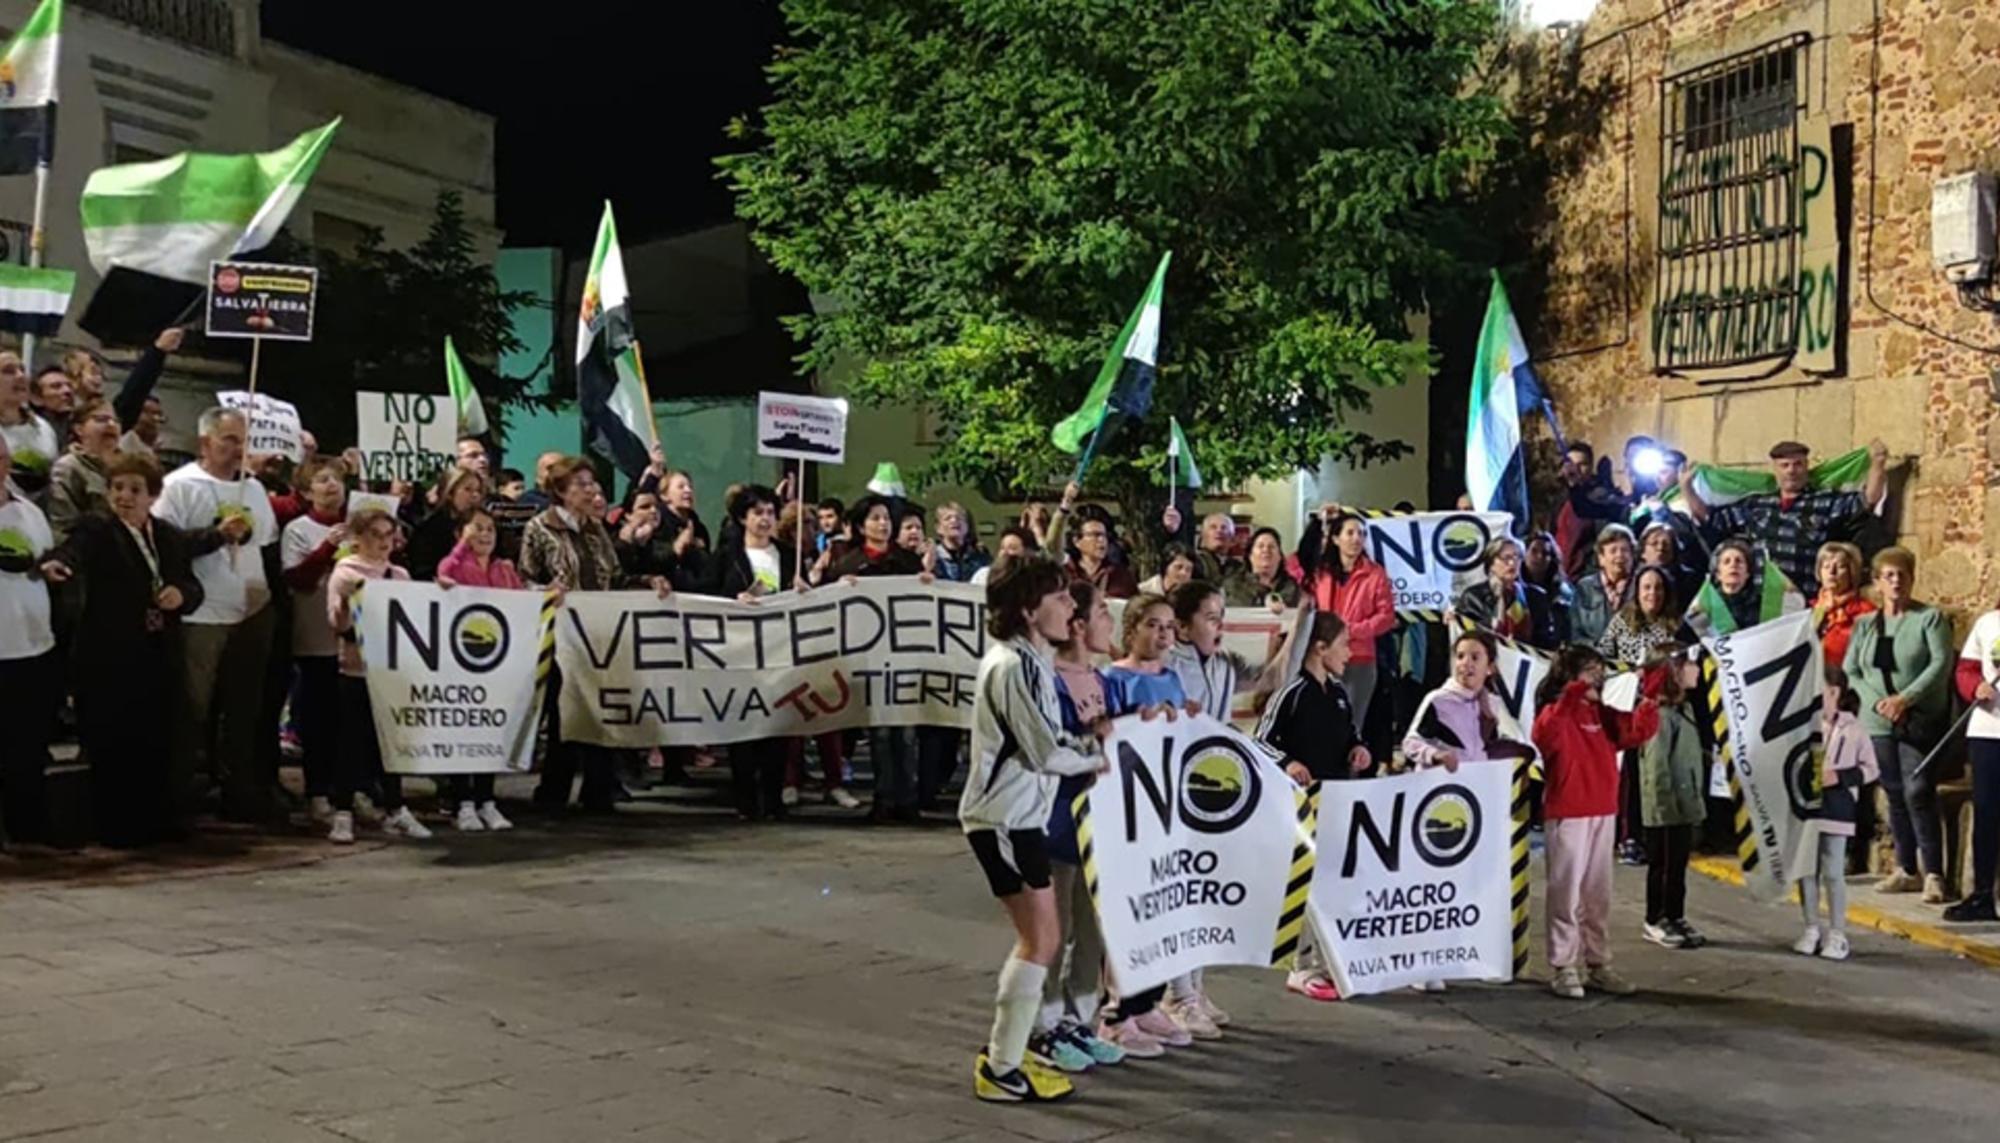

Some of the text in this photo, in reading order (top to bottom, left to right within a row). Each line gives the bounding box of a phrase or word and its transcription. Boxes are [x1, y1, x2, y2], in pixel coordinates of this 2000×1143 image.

[1661, 144, 1827, 258] STOP
[384, 392, 436, 425] NO
[392, 423, 430, 455] AL
[1369, 514, 1491, 574] NO
[388, 598, 510, 673] NO
[410, 684, 487, 704] MACRO
[600, 686, 770, 725] SALVA
[774, 669, 850, 722] TU
[391, 706, 507, 727] VERTEDERO
[433, 744, 453, 758] TU
[1117, 736, 1263, 842] NO
[1341, 783, 1482, 878] NO
[1150, 849, 1218, 885] MACRO
[1128, 879, 1247, 923] VERTEDERO
[1366, 881, 1456, 913] MACRO
[1336, 904, 1480, 940] VERTEDERO
[1348, 946, 1479, 977] ALVA TU TIERRA
